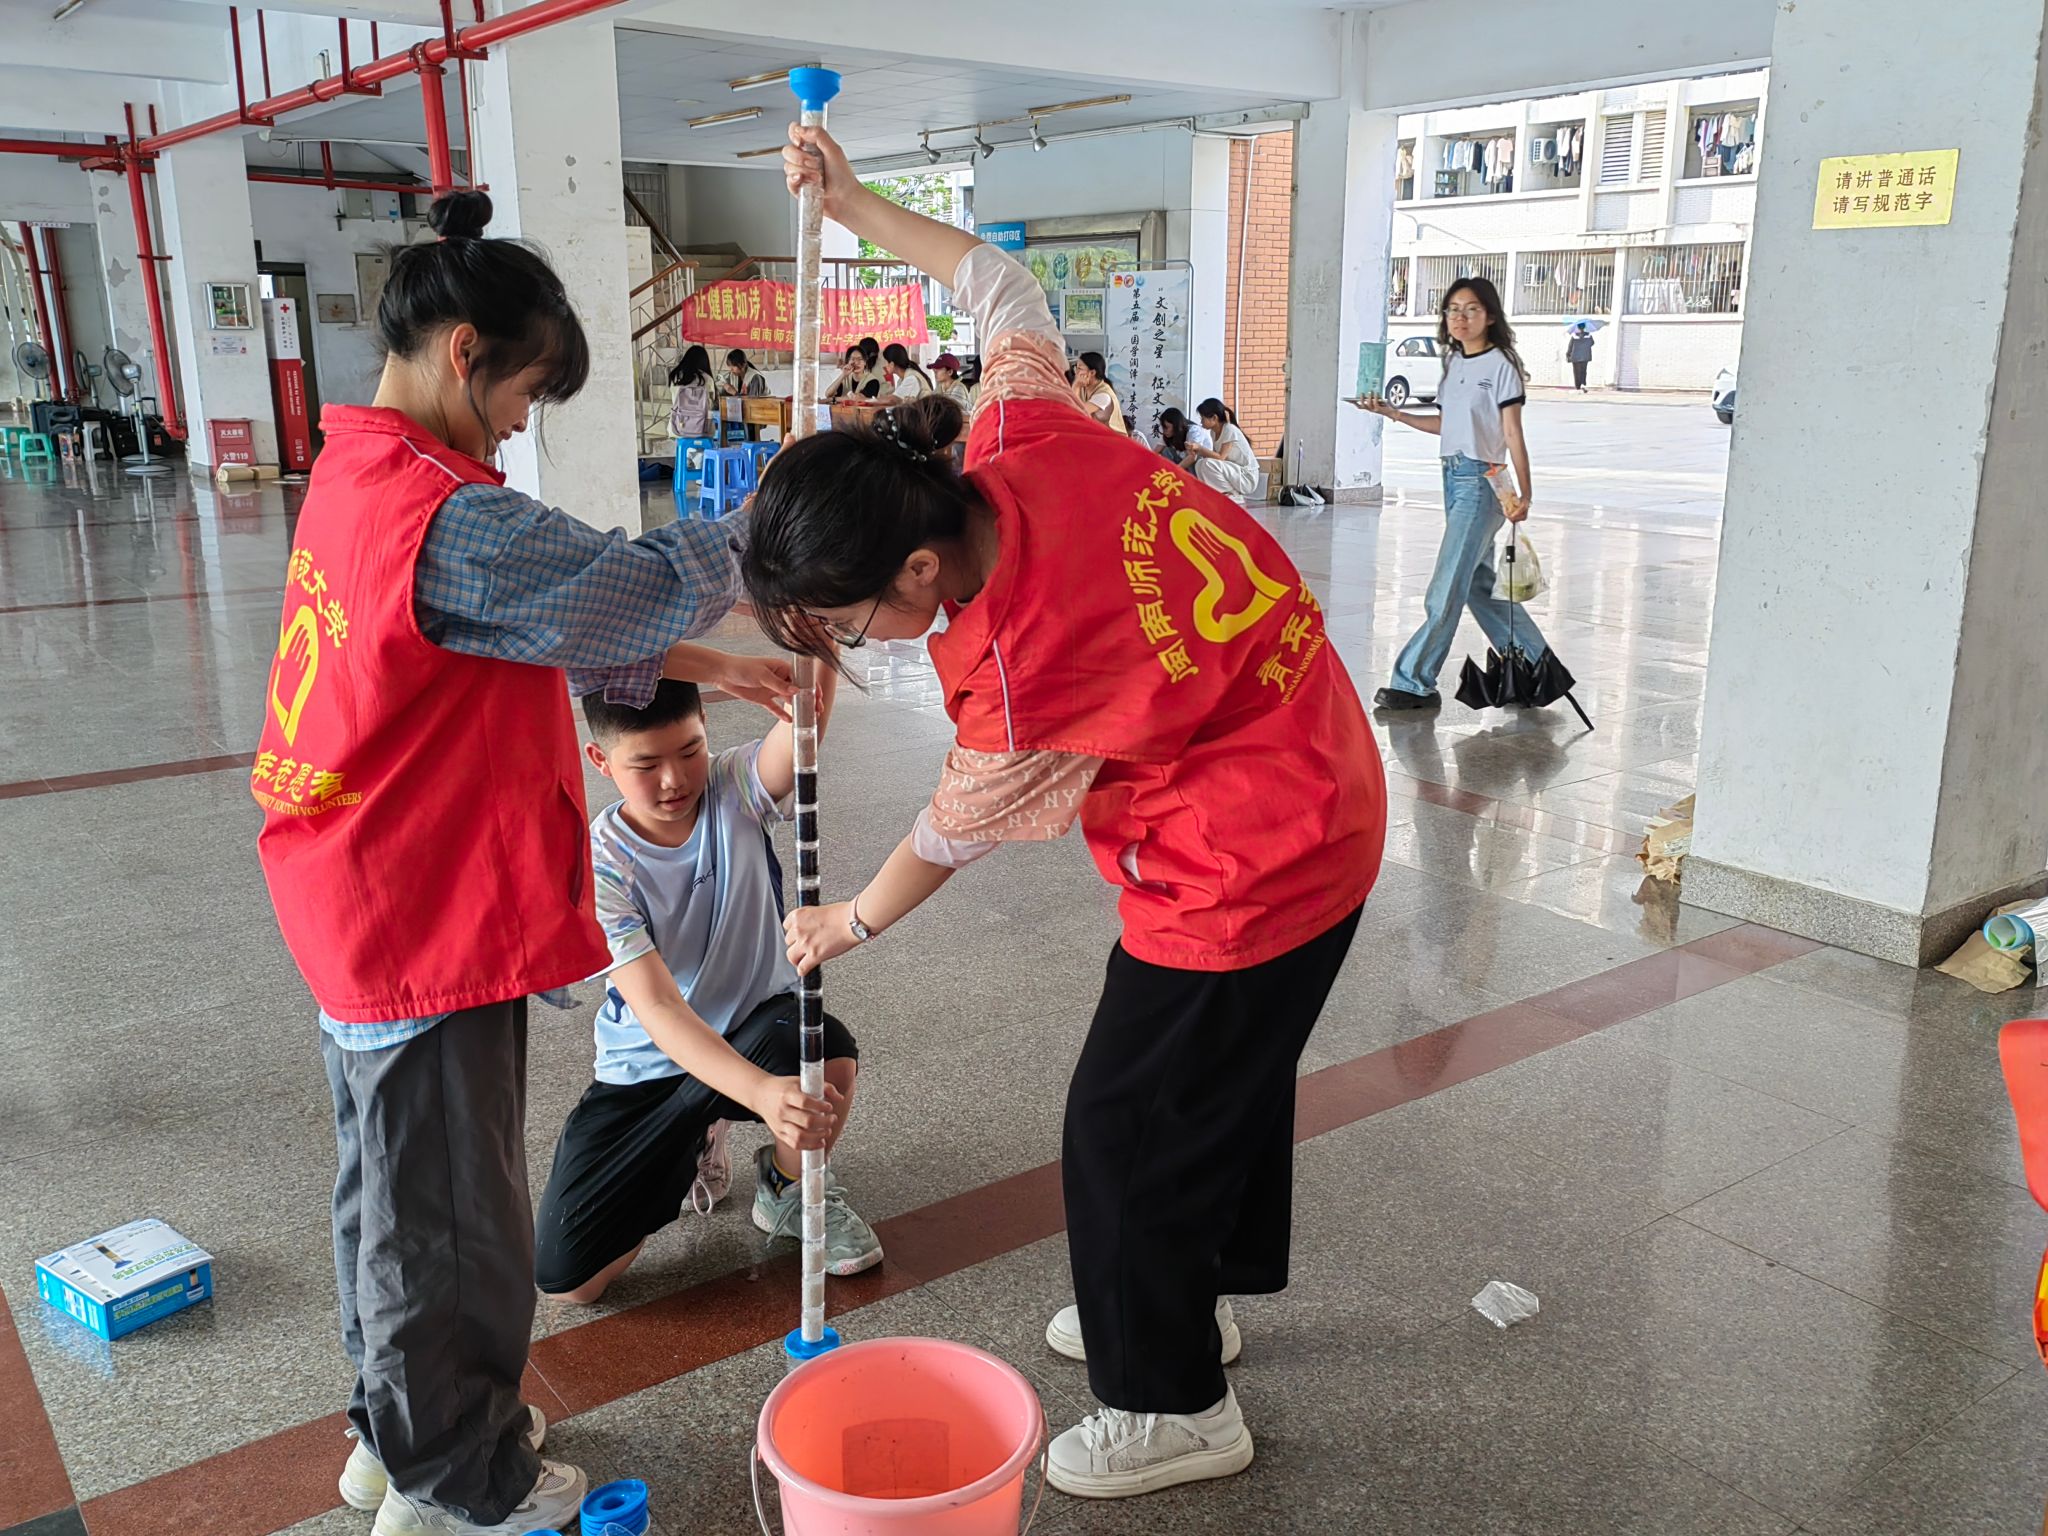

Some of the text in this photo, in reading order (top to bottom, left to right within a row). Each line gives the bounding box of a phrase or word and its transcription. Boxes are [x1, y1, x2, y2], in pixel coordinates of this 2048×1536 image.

[1836, 166, 1936, 190] 请讲普通话
[1833, 192, 1933, 214] 请写规范字
[222, 452, 249, 461] 火警119
[1120, 468, 1199, 684] 闽南师范大学
[300, 791, 363, 816] VOLUNTEERS
[1043, 789, 1077, 809] NY
[1007, 809, 1041, 829] NY
